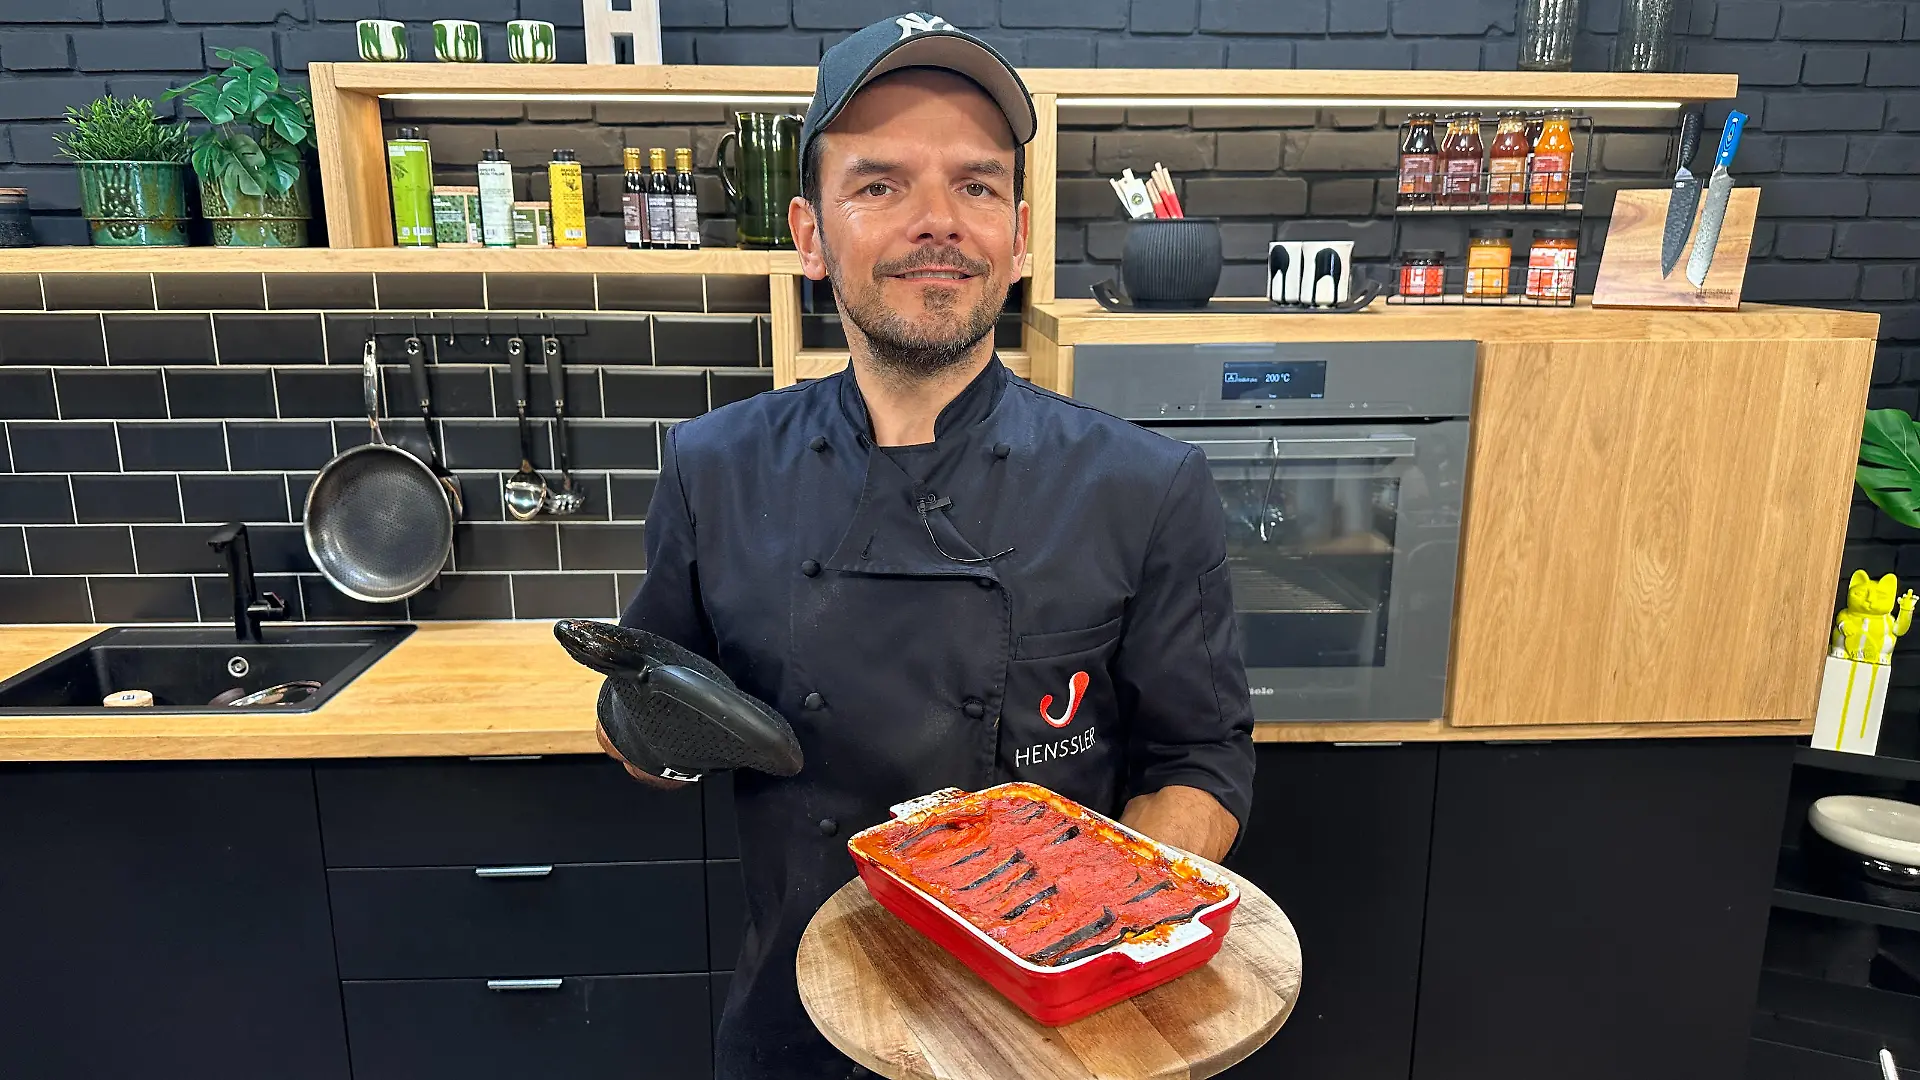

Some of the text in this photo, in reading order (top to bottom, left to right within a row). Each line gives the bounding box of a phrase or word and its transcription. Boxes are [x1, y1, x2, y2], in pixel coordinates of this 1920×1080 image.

[1413, 266, 1425, 281] H
[1265, 373, 1280, 382] 200
[1249, 687, 1274, 695] iele
[1015, 726, 1096, 767] HENSSLER
